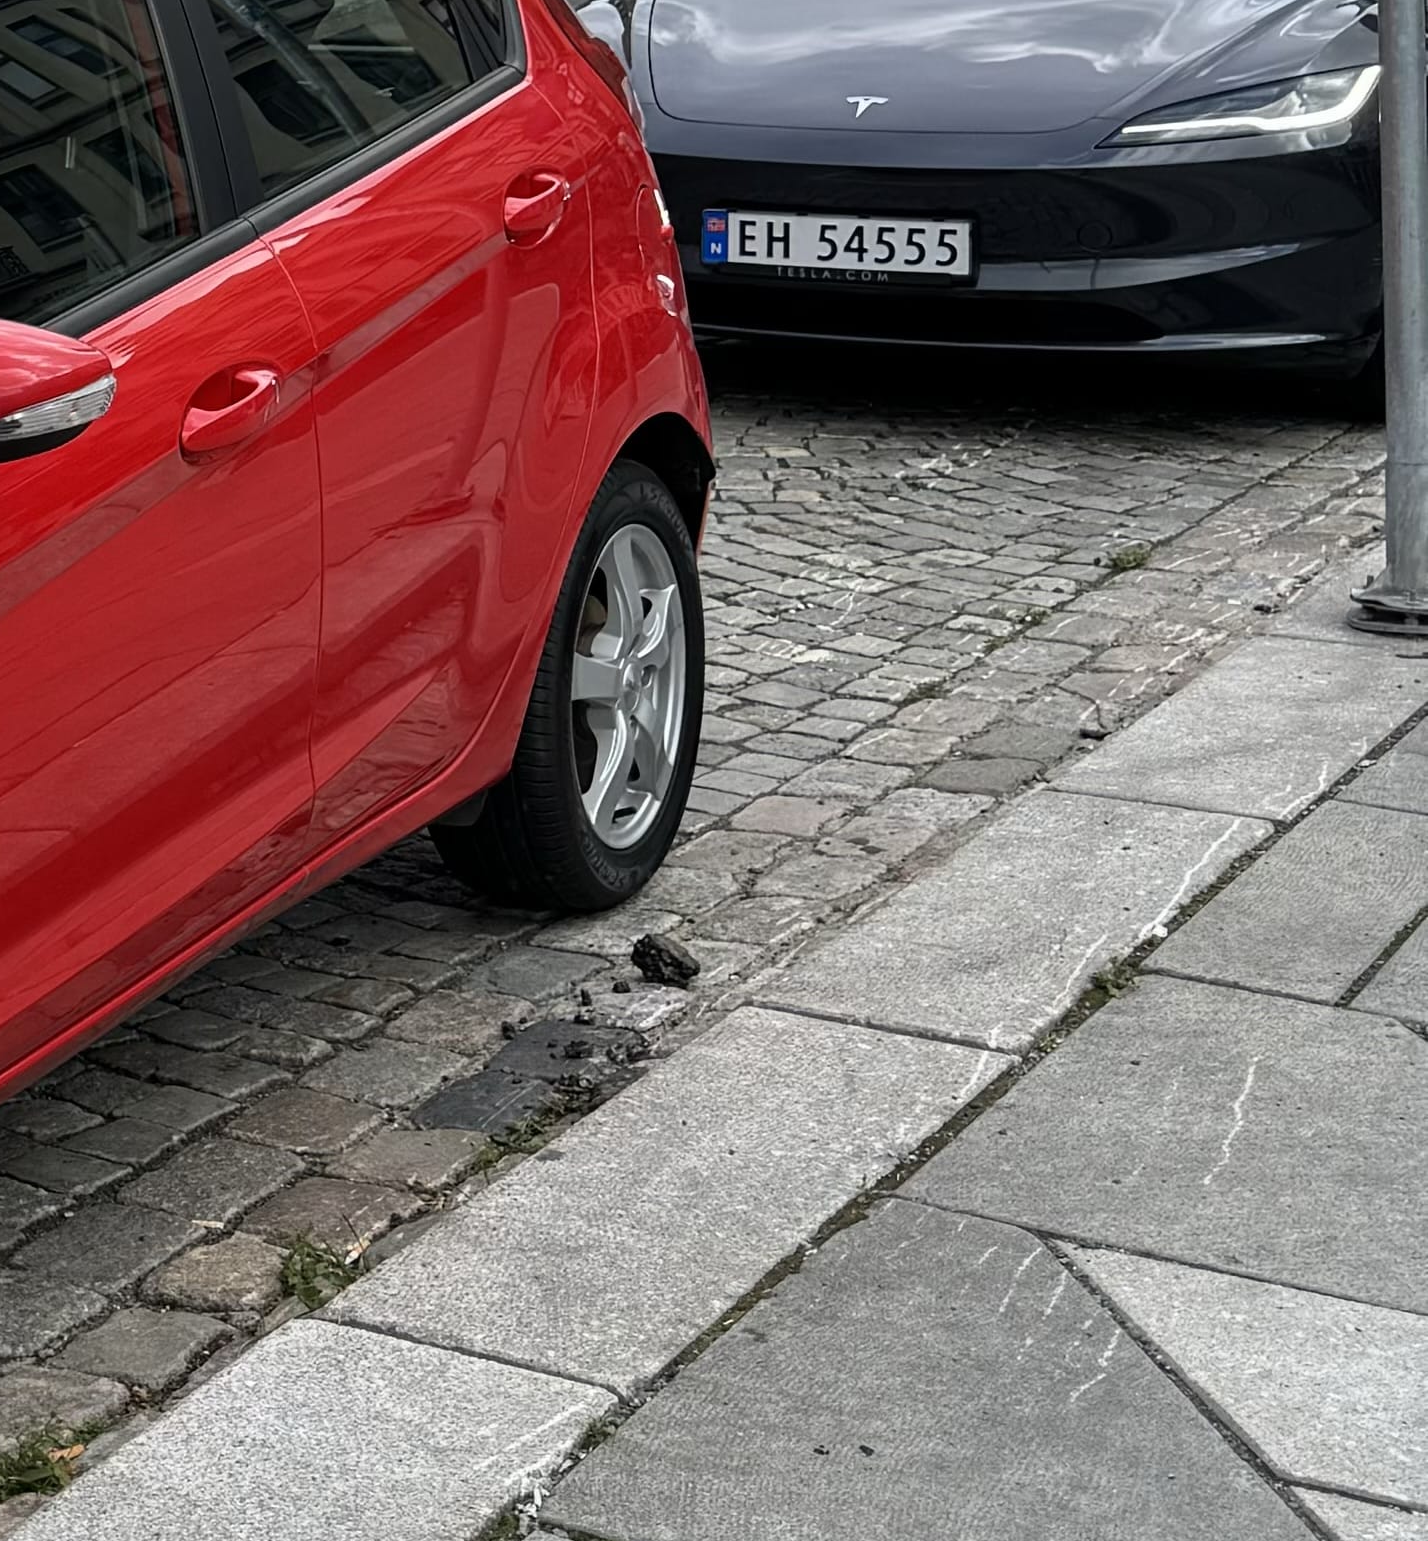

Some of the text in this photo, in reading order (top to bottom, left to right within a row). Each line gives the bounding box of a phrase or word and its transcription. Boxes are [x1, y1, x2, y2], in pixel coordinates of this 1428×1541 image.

[710, 242, 722, 255] N
[739, 220, 959, 267] EH 54555
[777, 266, 888, 283] TESLA.COM
